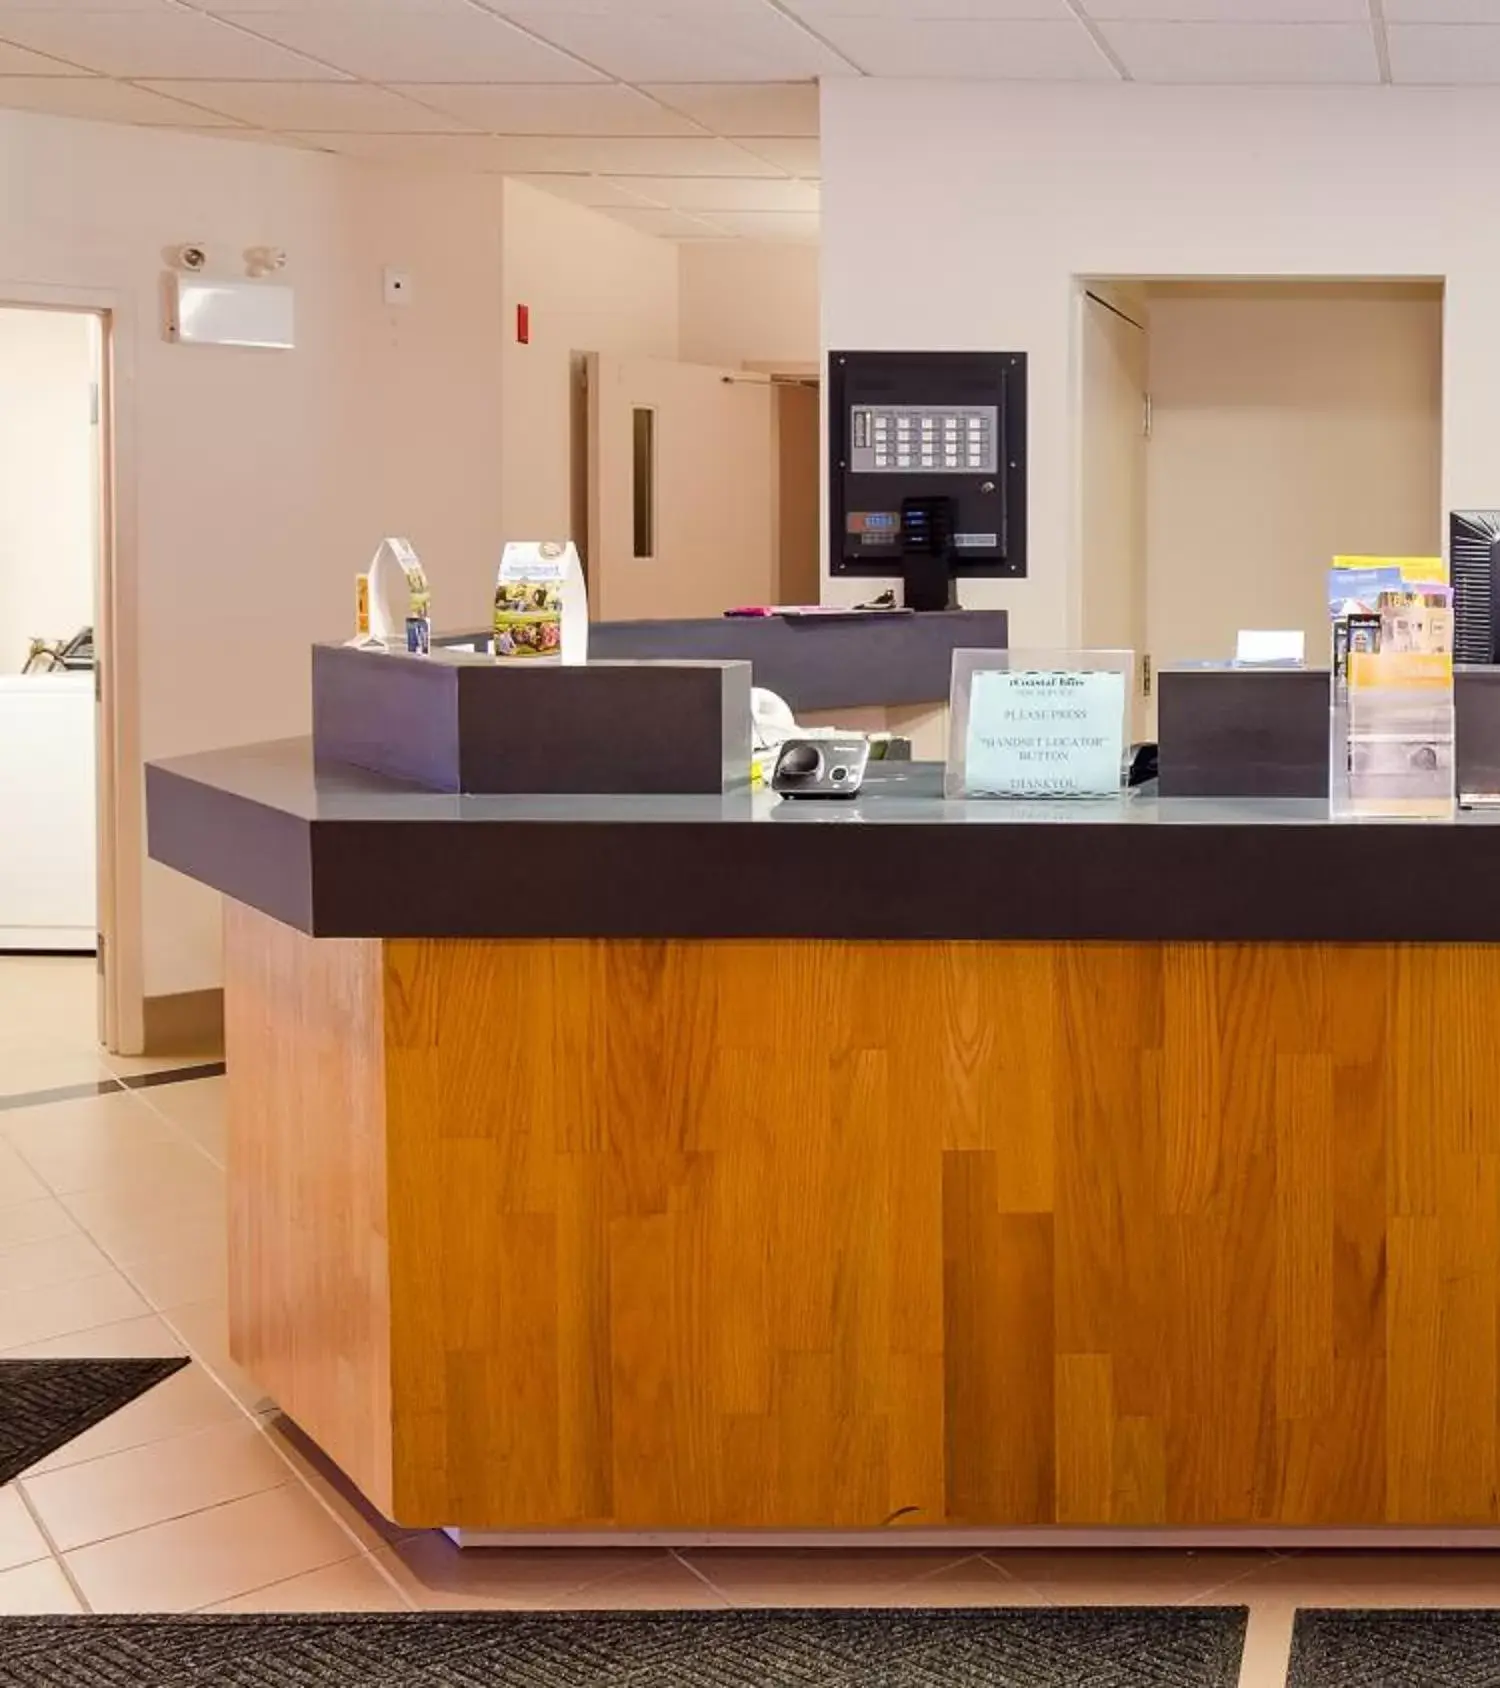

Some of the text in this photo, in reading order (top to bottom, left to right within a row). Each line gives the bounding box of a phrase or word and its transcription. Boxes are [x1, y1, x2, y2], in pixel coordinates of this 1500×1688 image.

[1004, 709, 1087, 721] PLEASE PRESS
[1018, 751, 1069, 762] BUTTON
